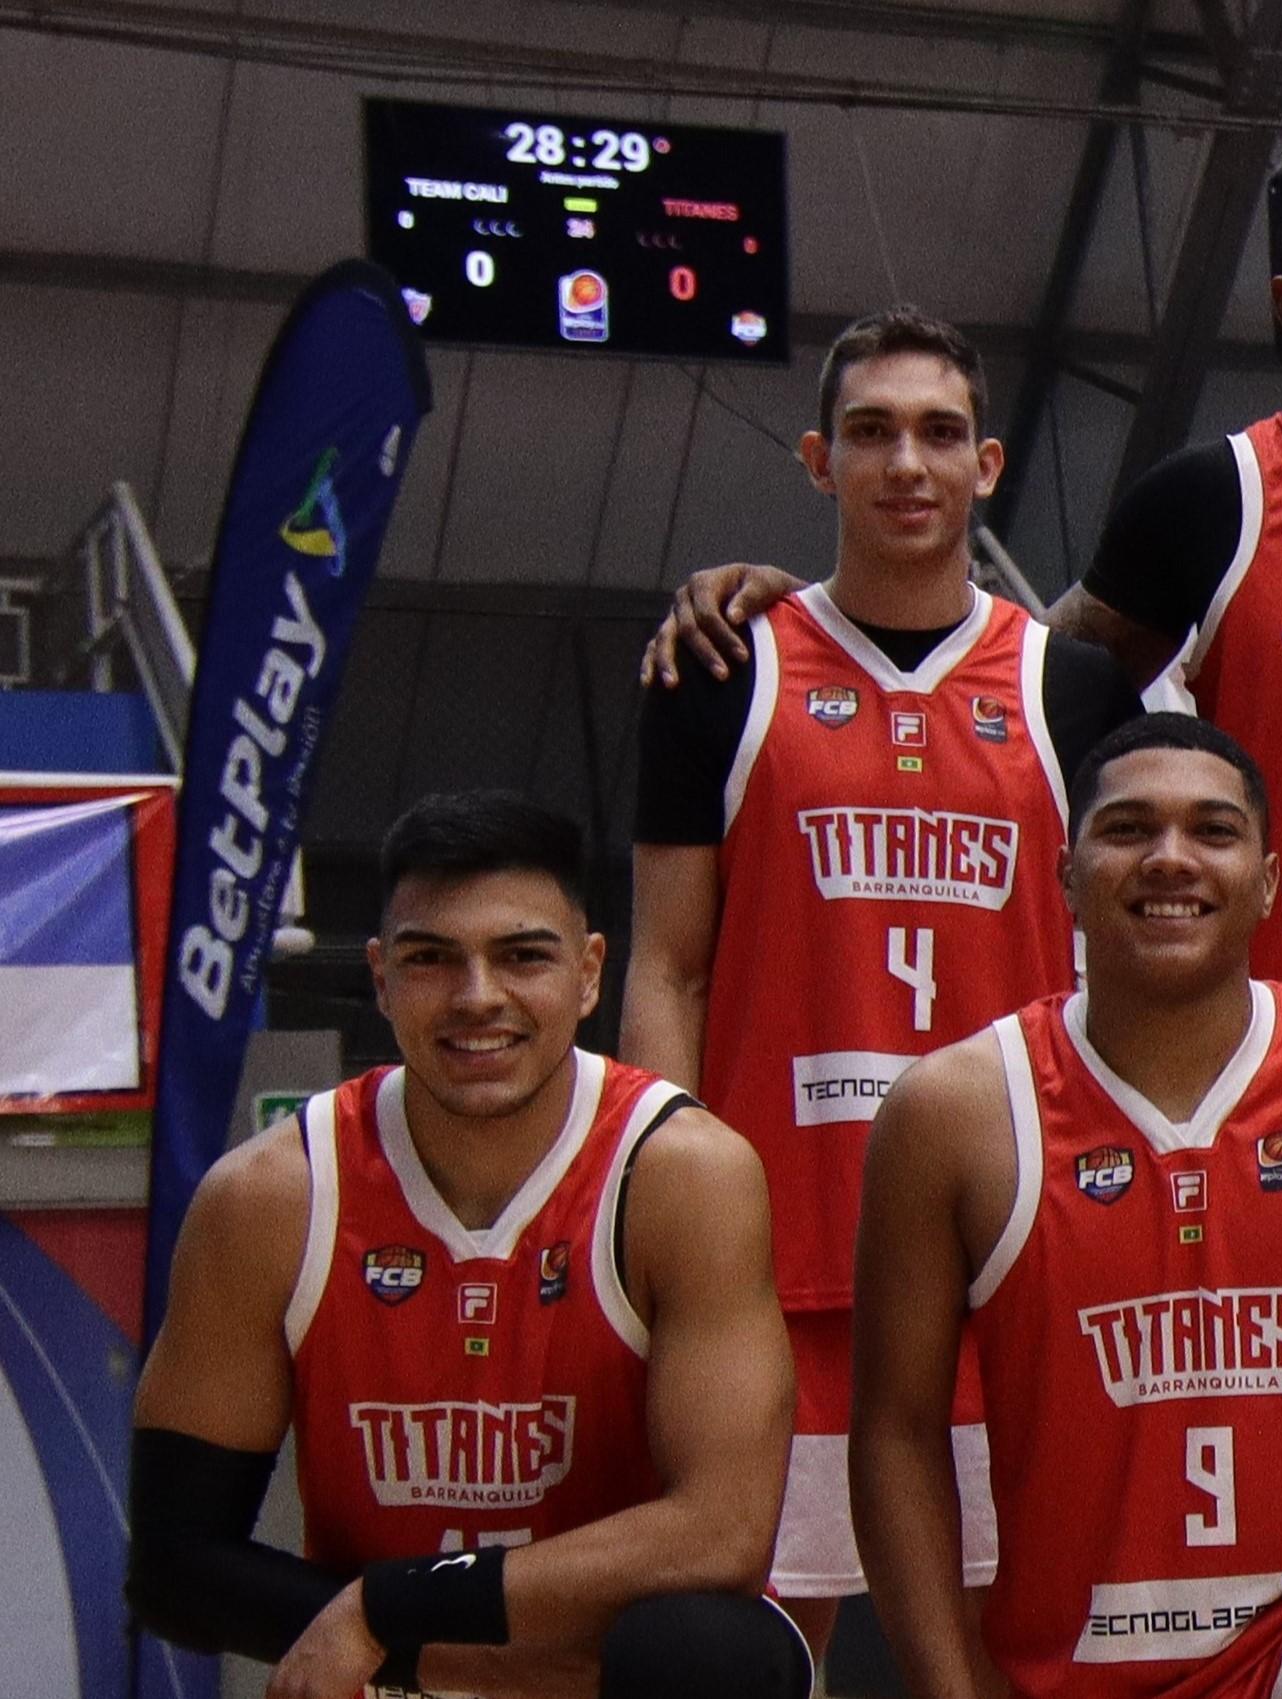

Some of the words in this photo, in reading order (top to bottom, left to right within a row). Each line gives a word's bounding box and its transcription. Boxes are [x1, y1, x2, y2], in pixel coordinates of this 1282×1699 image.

[504, 123, 651, 172] 28:29
[405, 178, 463, 200] TEAM
[464, 182, 508, 203] CALI
[662, 200, 740, 221] TITANES
[465, 251, 495, 287] 0
[669, 265, 697, 301] 0
[808, 698, 859, 717] FCB
[177, 572, 329, 1022] BetPlay
[804, 811, 1013, 889] TITANES
[851, 880, 981, 902] BARRANQUILLA
[887, 927, 937, 1032] 4
[1078, 1165, 1134, 1190] FCB
[366, 1266, 423, 1288] FCB
[1138, 1375, 1280, 1397] BARRANQUILLA
[358, 1403, 566, 1485] TITANES
[1185, 1426, 1237, 1547] 9
